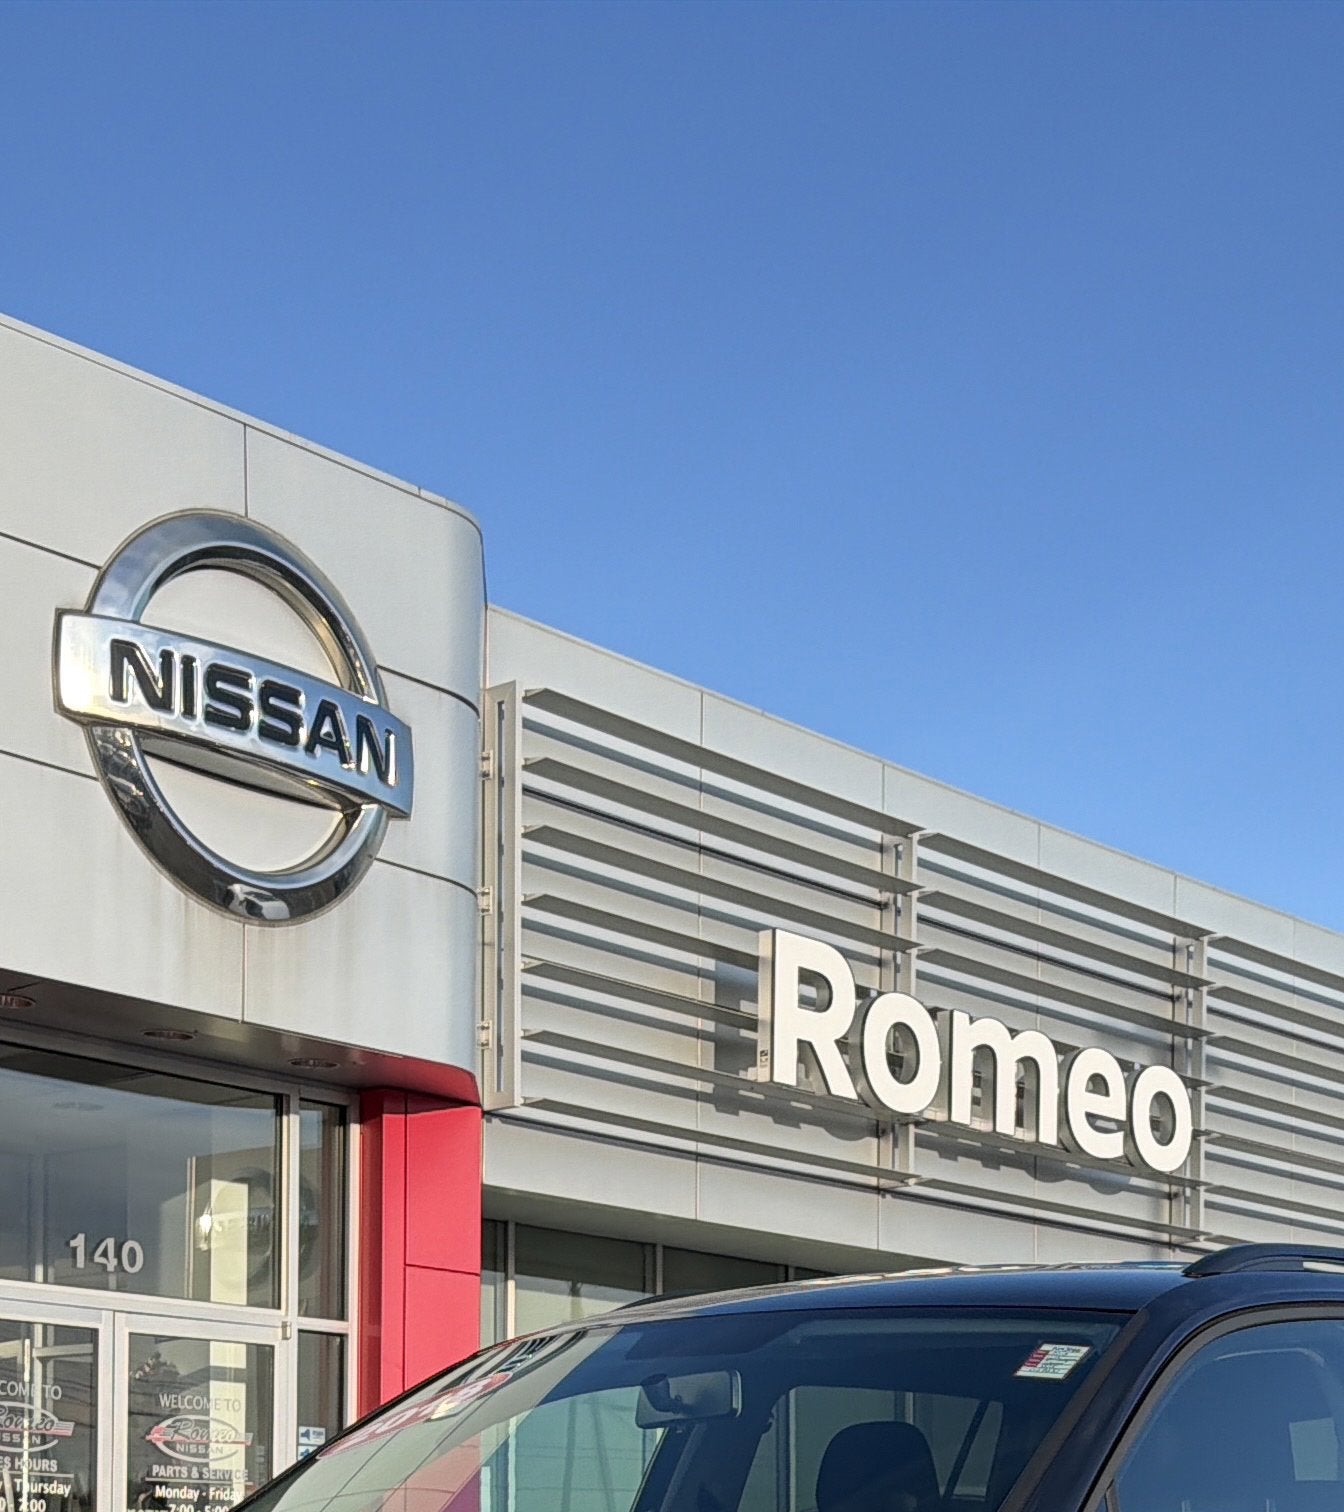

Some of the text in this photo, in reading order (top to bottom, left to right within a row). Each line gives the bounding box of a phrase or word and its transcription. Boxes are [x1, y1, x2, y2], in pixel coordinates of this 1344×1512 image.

[109, 637, 398, 788] NISSAN
[770, 927, 1193, 1173] Romeo
[69, 1233, 144, 1274] 140
[43, 1384, 62, 1400] TO
[158, 1392, 242, 1413] WELCOME TO
[176, 1442, 224, 1455] NISSAN
[14, 1457, 58, 1472] HOURS
[152, 1464, 249, 1481] PARTS & SERVICE
[155, 1485, 199, 1502] Monday
[209, 1486, 244, 1503] Friday
